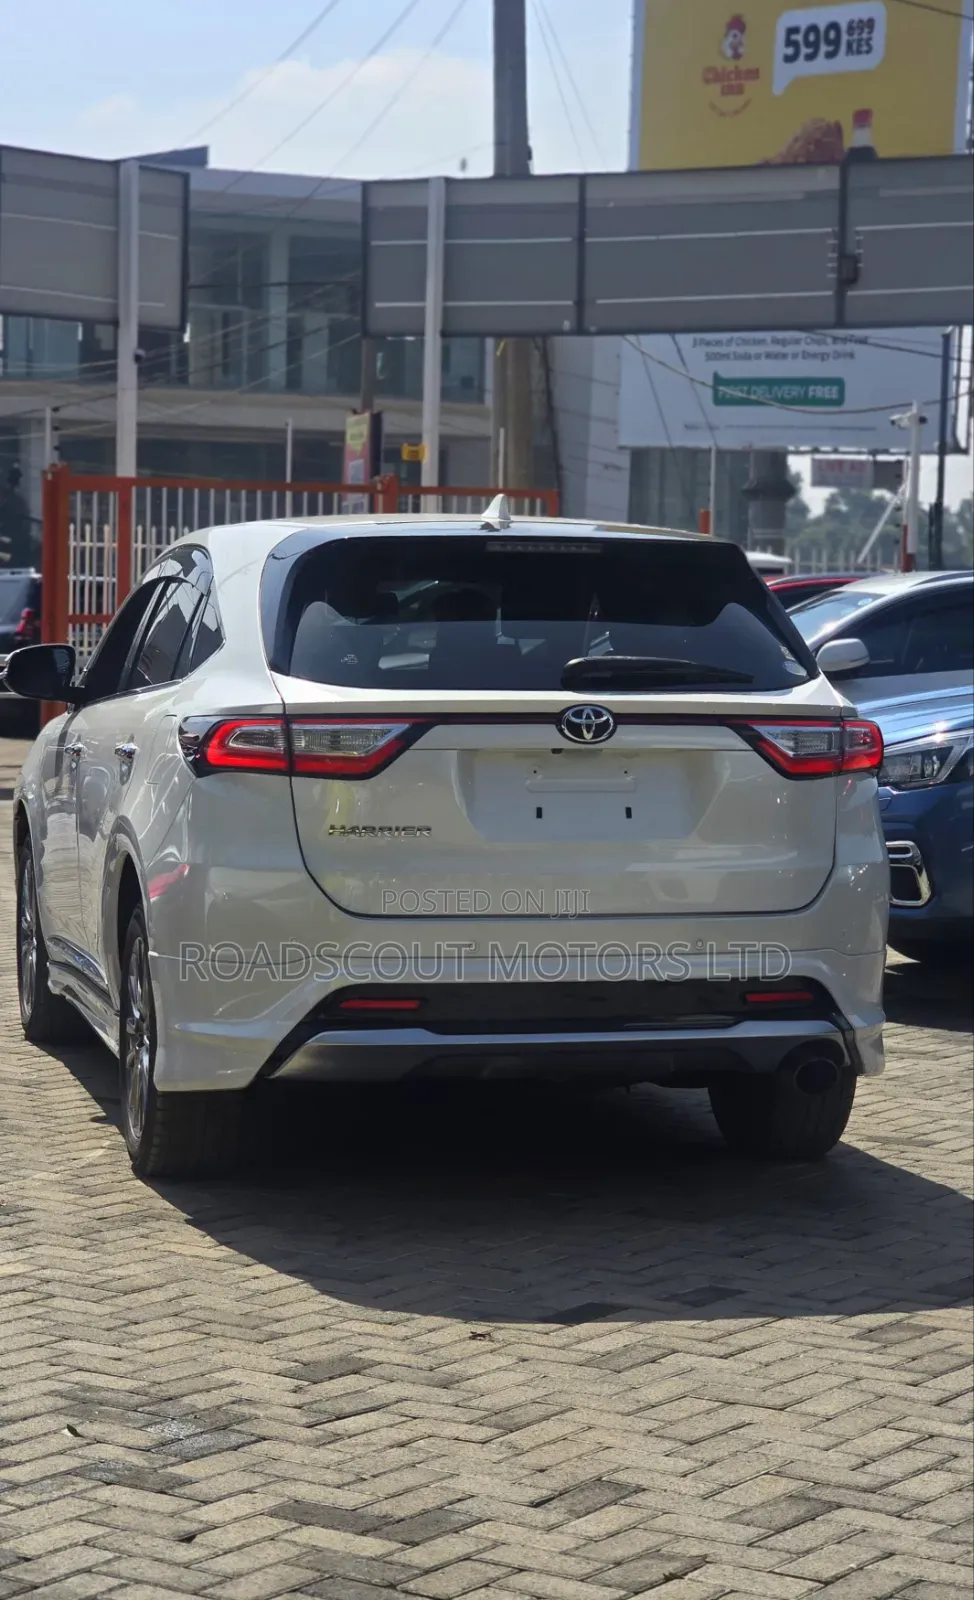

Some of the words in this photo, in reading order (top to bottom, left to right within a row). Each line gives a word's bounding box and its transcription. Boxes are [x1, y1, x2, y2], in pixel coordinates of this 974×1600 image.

[845, 17, 876, 37] 699
[782, 21, 842, 64] 599
[845, 37, 873, 56] KES
[750, 385, 806, 399] DELIVERY
[807, 385, 840, 399] FREE
[328, 824, 432, 837] HARRIER
